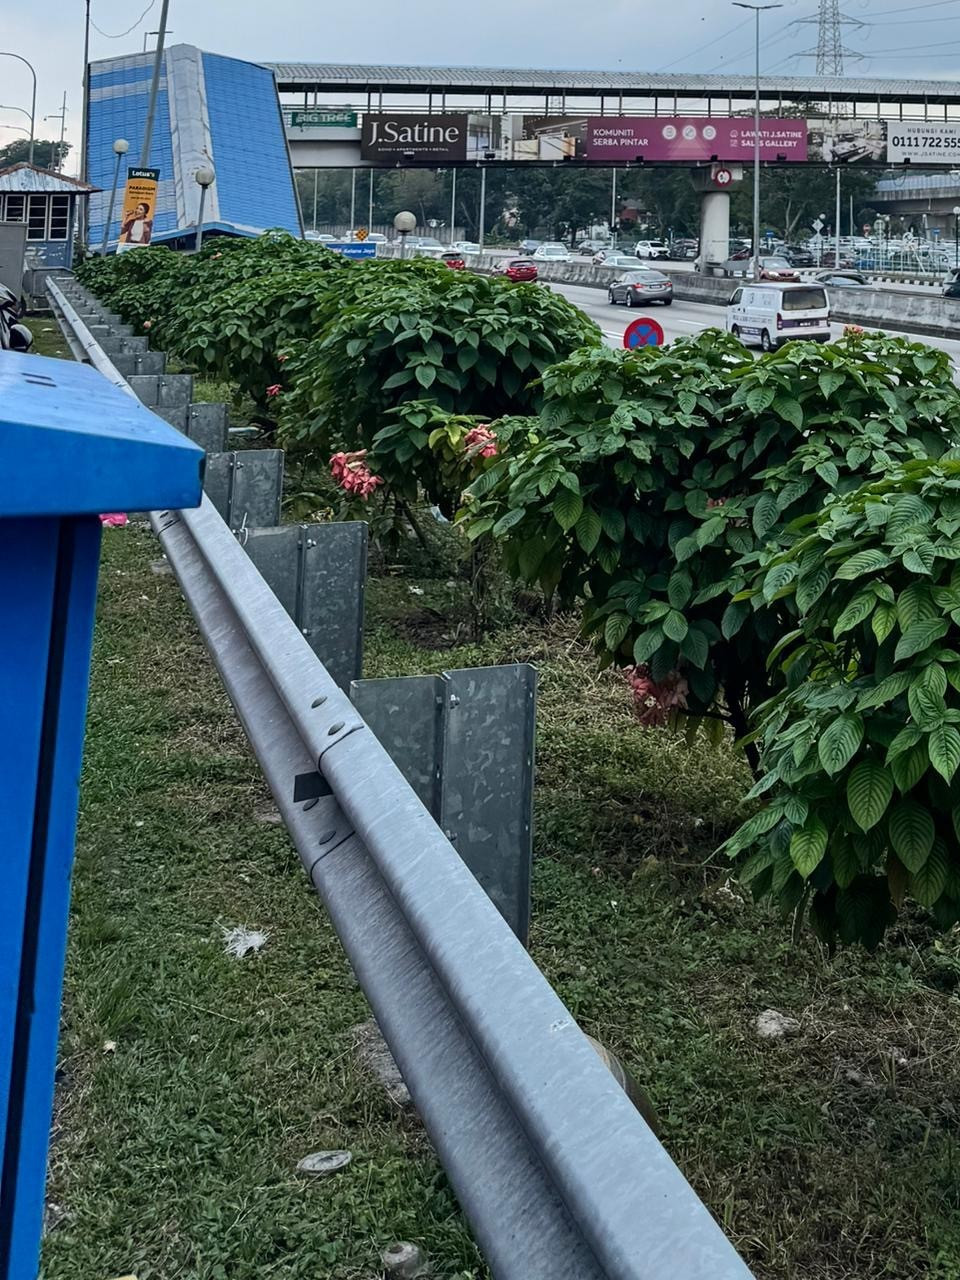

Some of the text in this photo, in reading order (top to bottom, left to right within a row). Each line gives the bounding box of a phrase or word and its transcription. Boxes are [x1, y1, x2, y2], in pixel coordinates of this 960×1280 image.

[368, 121, 459, 146] J.Satine
[593, 129, 634, 137] KOMUNITI
[770, 130, 803, 138] J.SATINE
[593, 138, 649, 147] SERBA PINTAR
[765, 140, 798, 148] GALLERY
[892, 136, 920, 147] 0111
[922, 136, 942, 148] 722
